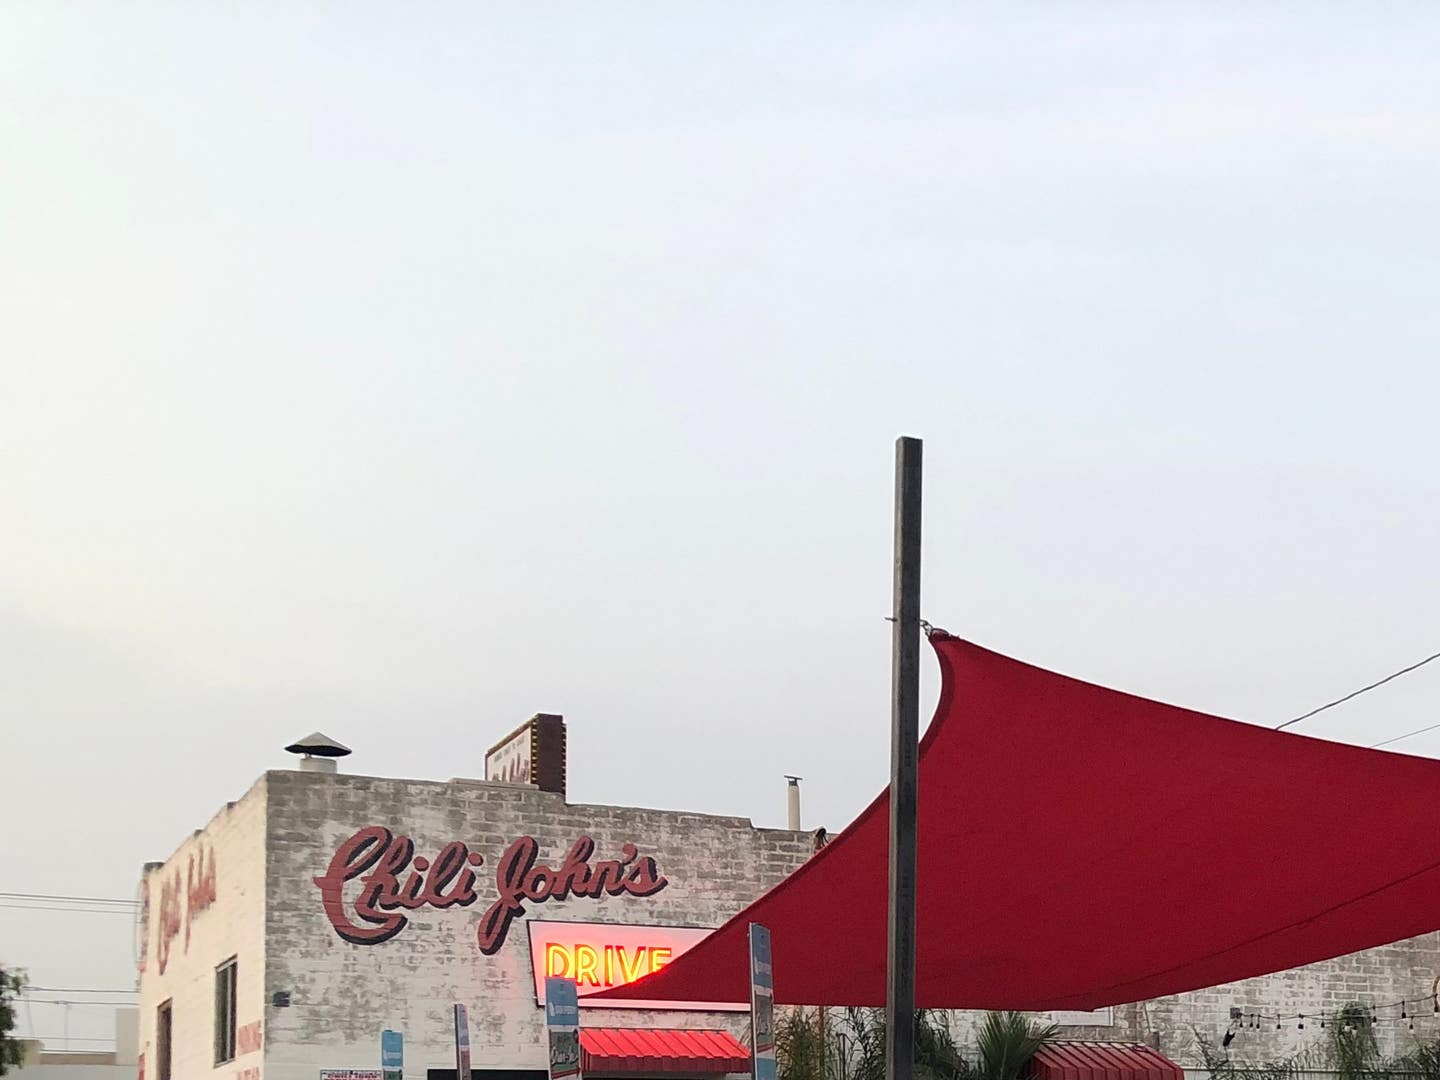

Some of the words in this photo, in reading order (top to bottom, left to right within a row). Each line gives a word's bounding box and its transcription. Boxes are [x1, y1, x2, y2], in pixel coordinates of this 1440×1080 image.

[312, 825, 484, 946] Chili
[477, 835, 669, 956] John's
[545, 942, 672, 987] DRIVE
